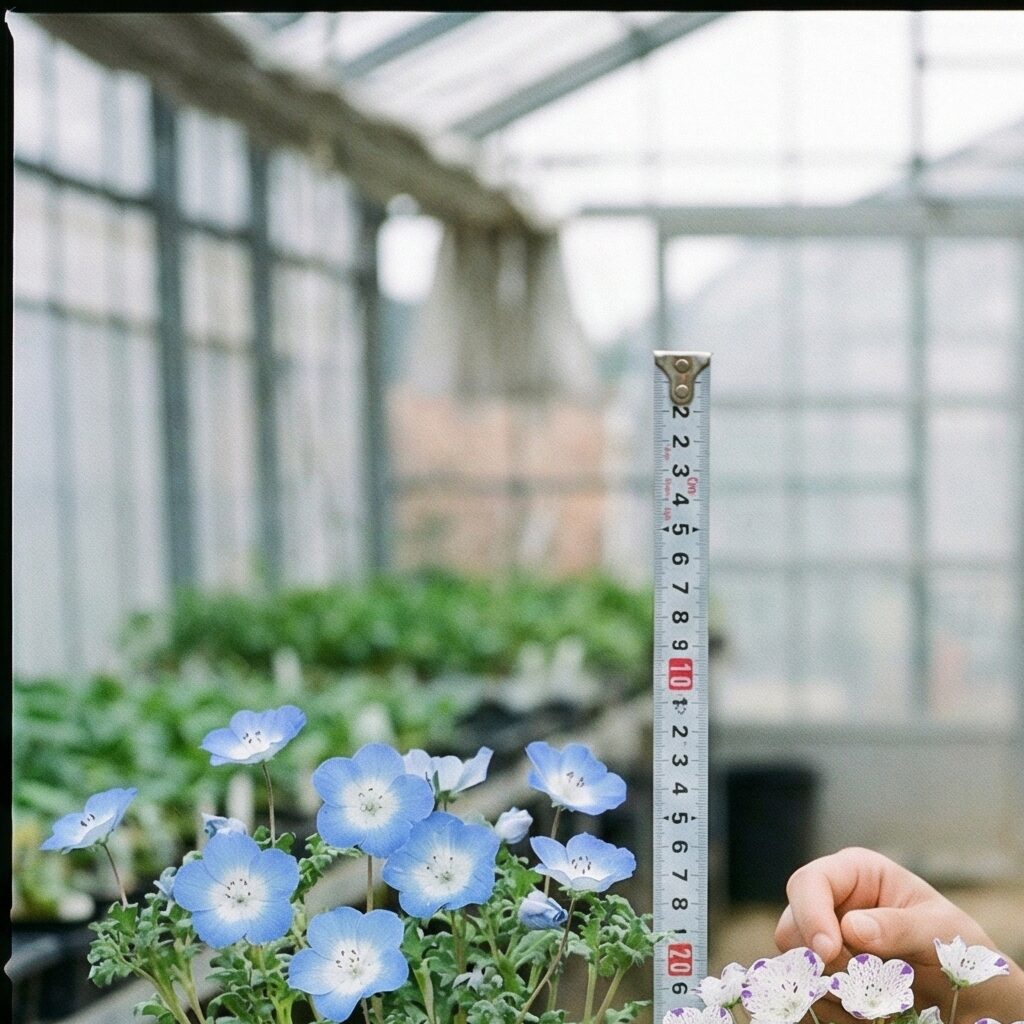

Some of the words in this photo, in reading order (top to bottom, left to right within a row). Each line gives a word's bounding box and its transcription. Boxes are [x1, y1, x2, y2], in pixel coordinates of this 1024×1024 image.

[671, 404, 690, 419] 2
[671, 434, 690, 449] 2
[671, 463, 690, 478] 3
[671, 492, 690, 507] 4
[671, 523, 690, 536] 5
[671, 552, 690, 566] 6
[671, 581, 690, 595] 7
[671, 610, 690, 624] 8
[671, 639, 690, 651] 9
[669, 663, 692, 687] 10
[671, 725, 690, 738] 2
[671, 753, 690, 767] 3
[671, 782, 690, 795] 4
[671, 812, 690, 825] 5
[671, 840, 690, 854] 6
[671, 869, 690, 882] 7
[671, 897, 690, 911] 8
[669, 948, 692, 973] 20
[671, 982, 690, 995] 6
